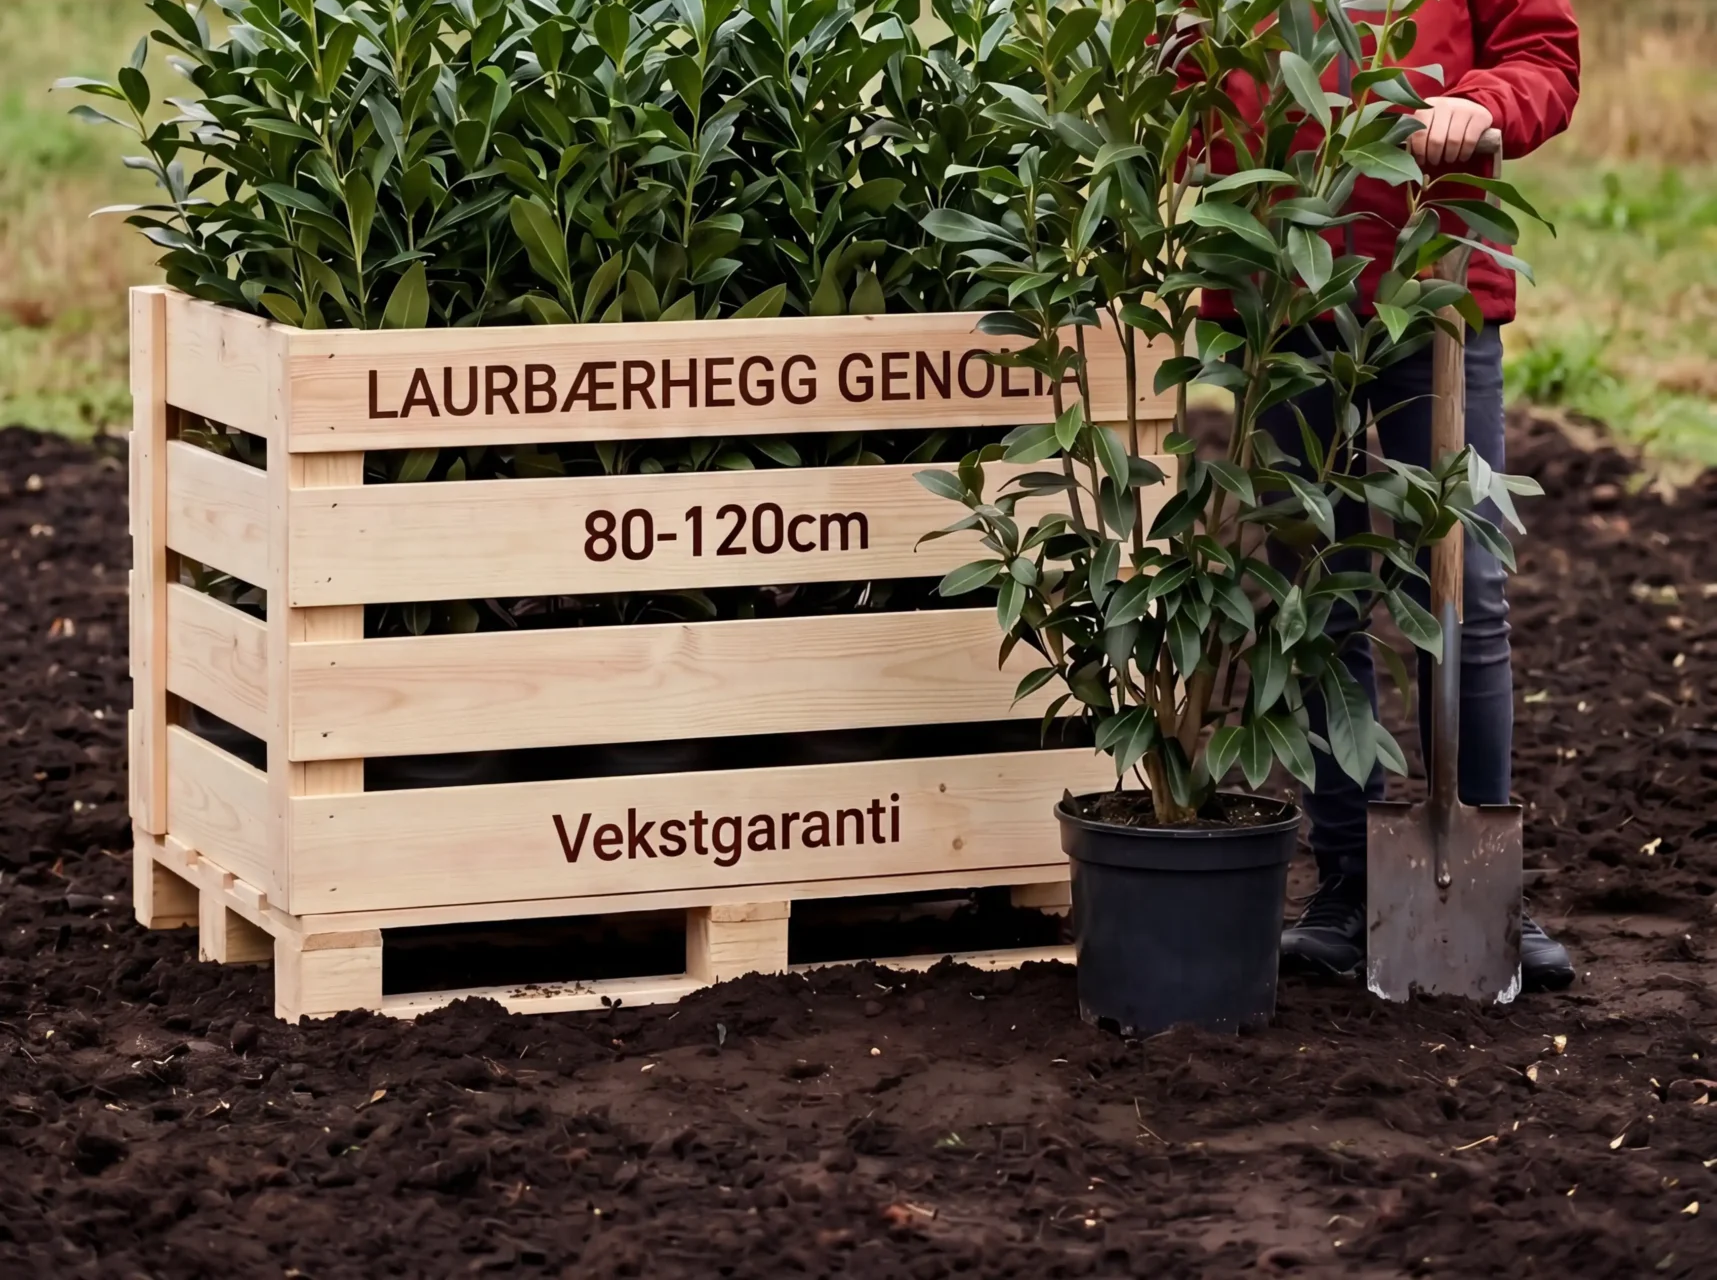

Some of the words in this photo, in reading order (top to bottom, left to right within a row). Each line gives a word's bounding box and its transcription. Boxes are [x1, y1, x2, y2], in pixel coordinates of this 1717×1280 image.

[368, 354, 817, 419] LAURBÆRHEGG
[584, 502, 869, 562] 80-120cm
[552, 792, 900, 867] Vekstgaranti
